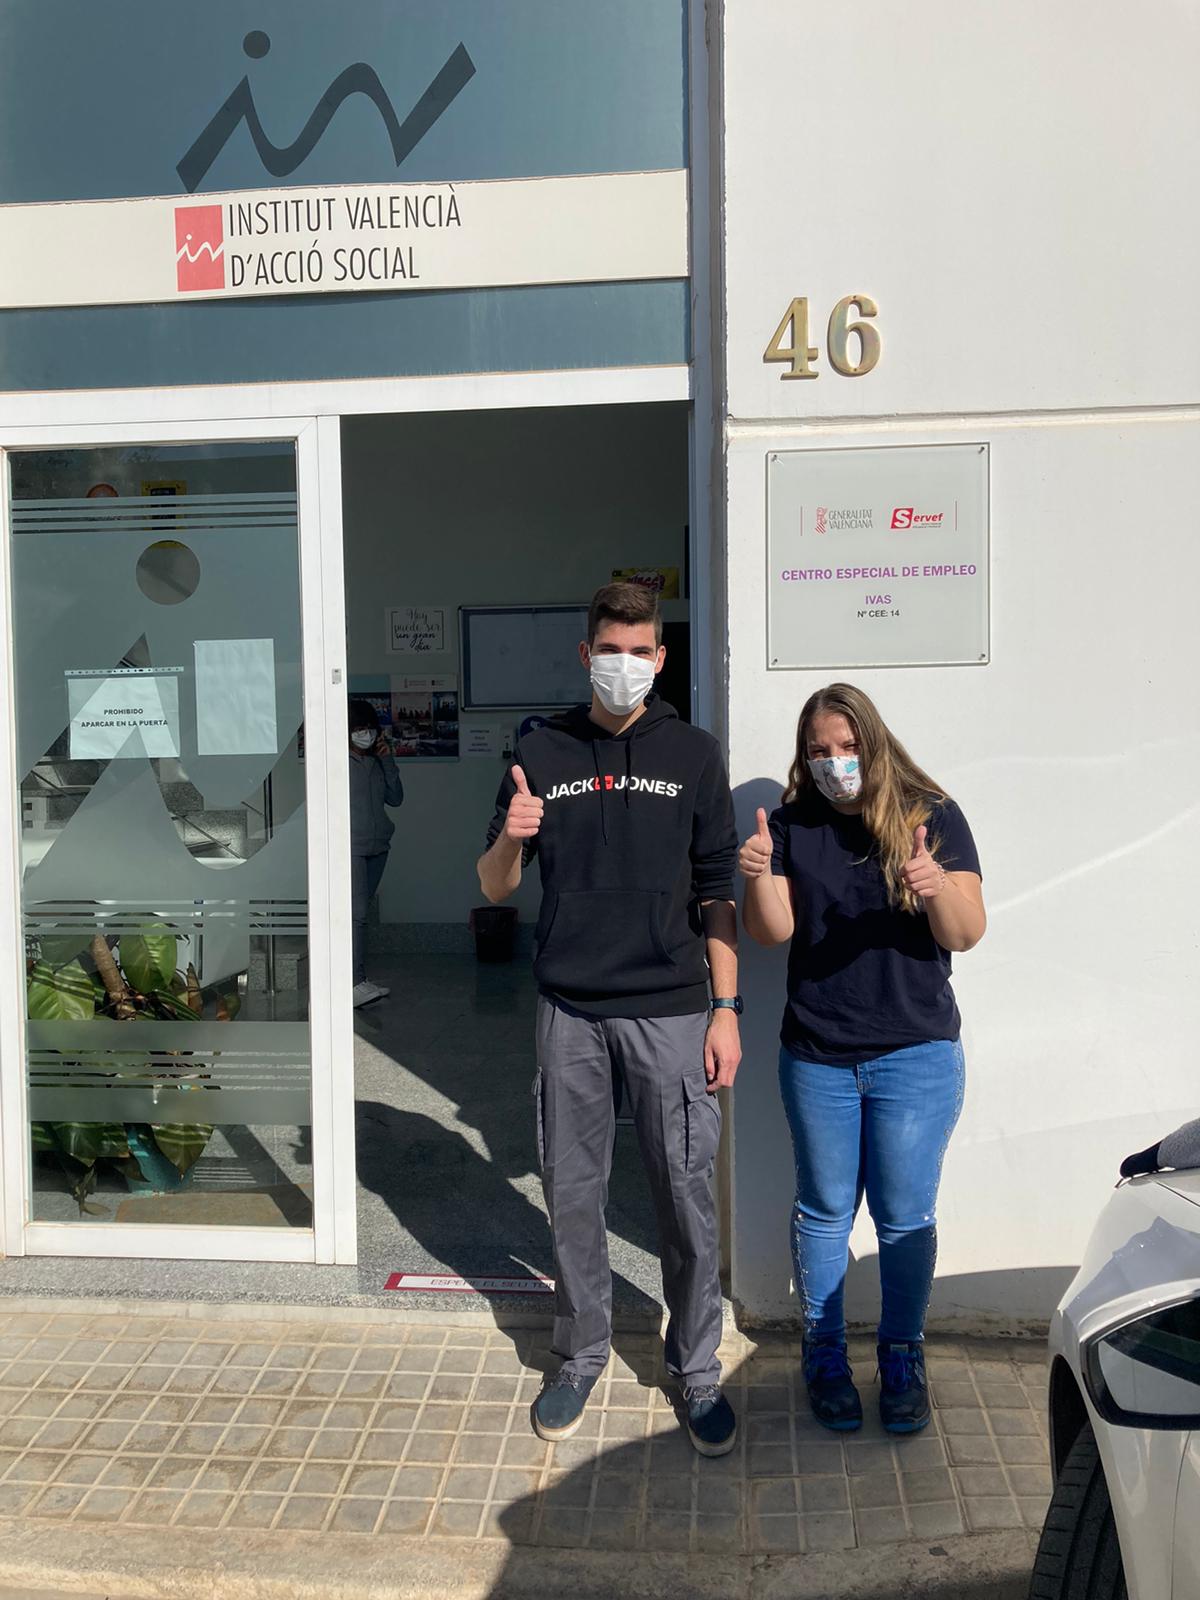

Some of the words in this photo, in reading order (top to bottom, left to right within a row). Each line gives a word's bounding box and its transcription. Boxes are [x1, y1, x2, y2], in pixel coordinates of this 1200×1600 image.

[229, 198, 336, 237] INSTITUT
[345, 183, 462, 231] VALENCIÀ
[231, 239, 323, 287] D'ACCIÓ
[333, 246, 420, 281] SOCIAL
[762, 294, 881, 381] 46
[828, 508, 873, 521] GENERALITAT
[828, 518, 874, 530] VALENCIANA
[893, 508, 944, 529] Servef
[781, 568, 833, 581] CENTRO
[836, 567, 898, 579] ESPECIAL
[902, 566, 919, 577] DE
[923, 564, 977, 577] EMPLEO
[865, 594, 892, 605] IVAS
[890, 609, 900, 617] 14
[546, 777, 595, 800] JACK
